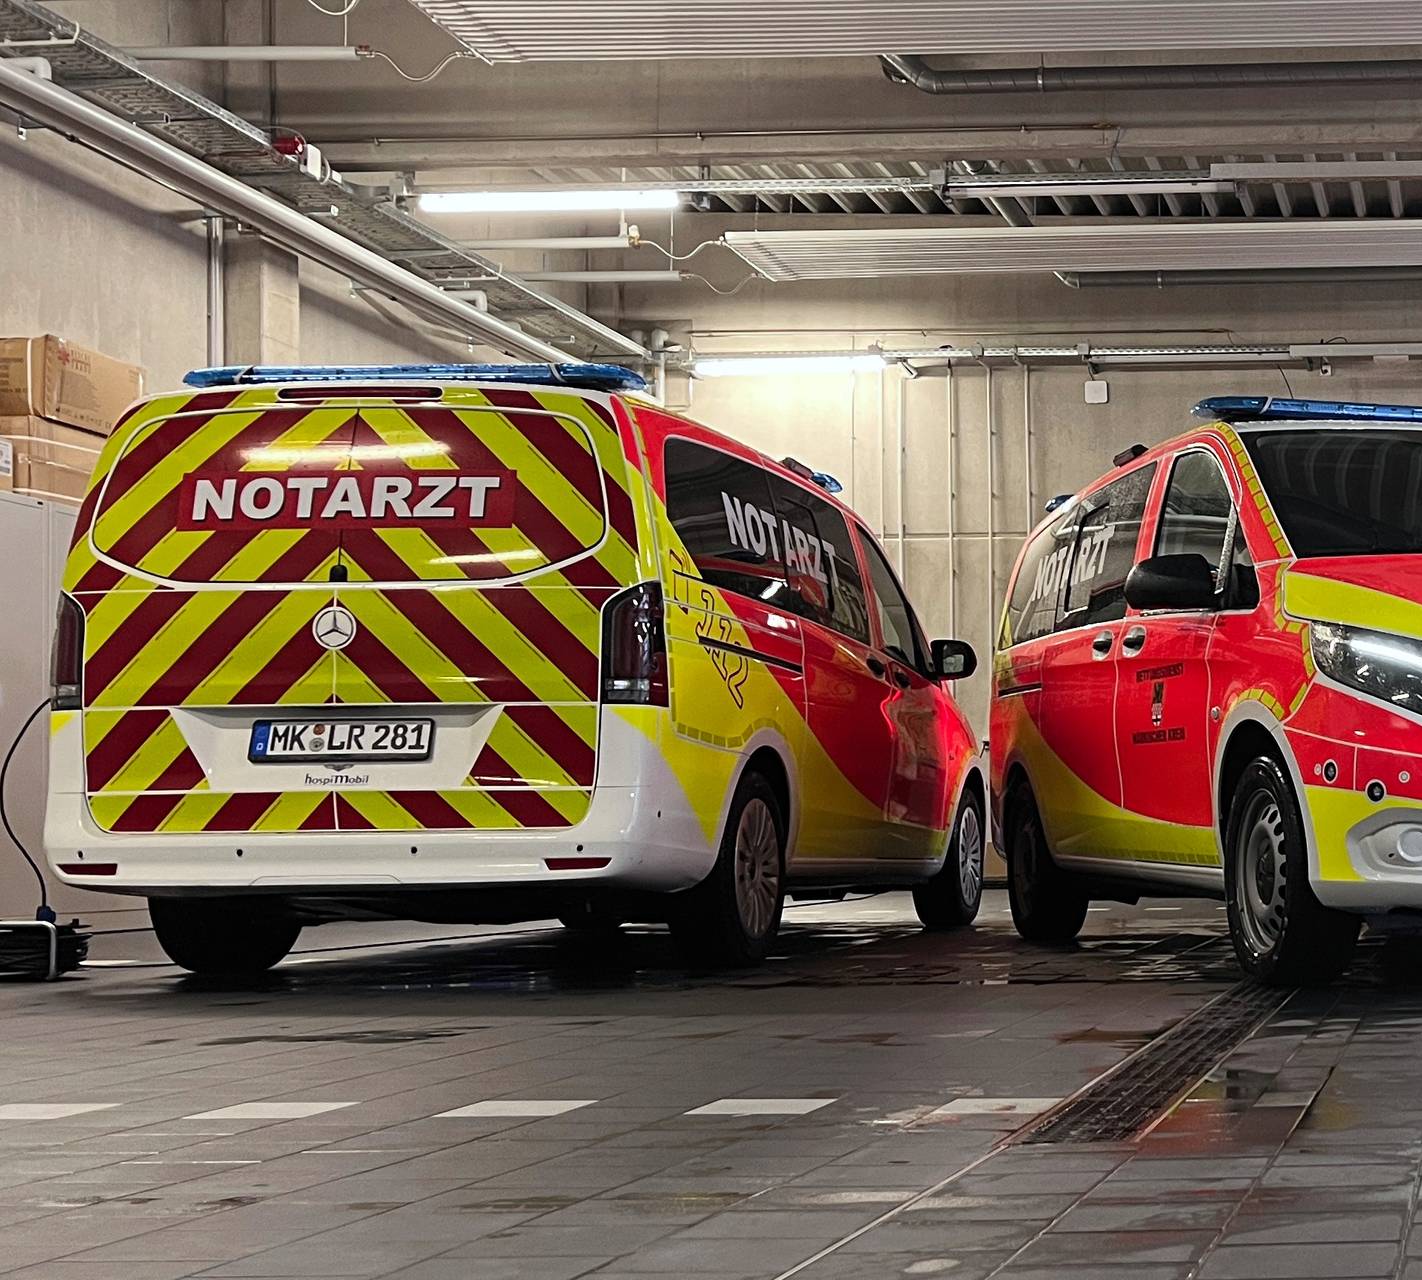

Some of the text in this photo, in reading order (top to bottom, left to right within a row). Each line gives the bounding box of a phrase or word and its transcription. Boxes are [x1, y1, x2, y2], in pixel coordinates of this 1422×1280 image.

[192, 476, 500, 521] NOTARZT
[721, 491, 840, 589] NOTARZT
[1031, 525, 1116, 602] NOTARZT
[255, 723, 425, 751] D MK LR 281
